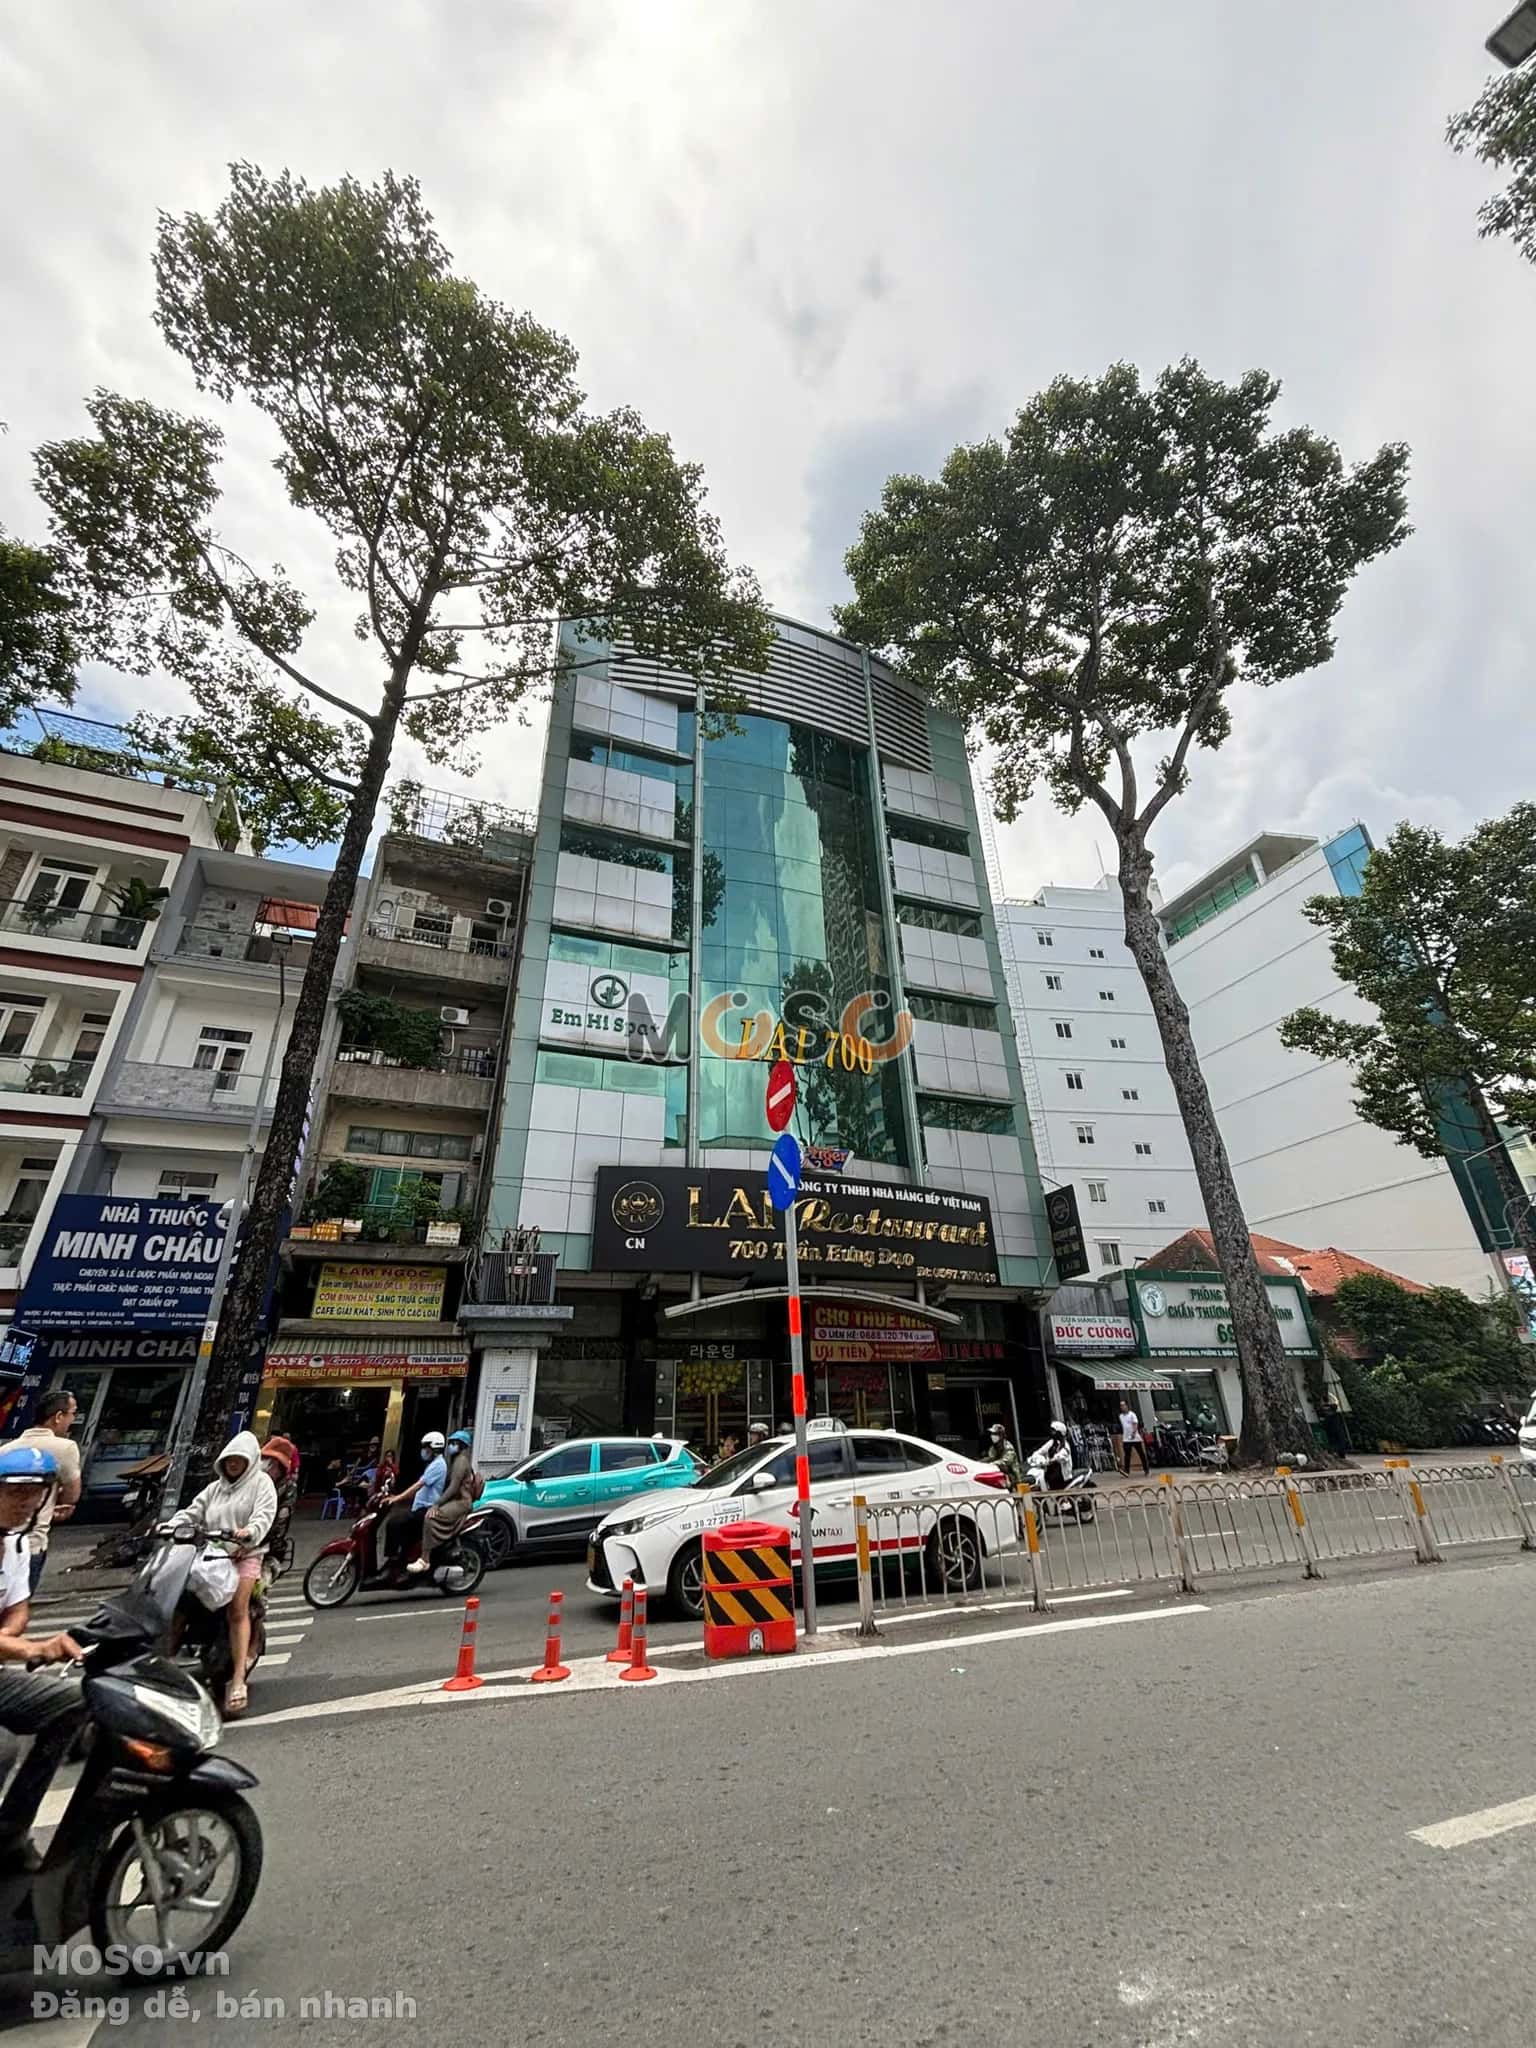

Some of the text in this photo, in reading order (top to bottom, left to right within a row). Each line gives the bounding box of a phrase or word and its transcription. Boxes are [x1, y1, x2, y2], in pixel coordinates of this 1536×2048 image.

[551, 1008, 649, 1037] Em Hi Spa
[736, 1018, 874, 1075] LAI 700
[824, 1183, 842, 1193] TY
[842, 1184, 869, 1197] TNHH
[873, 1186, 893, 1199] NHÀ
[896, 1189, 924, 1202] HÀNG
[925, 1191, 941, 1205] BẾP
[941, 1196, 961, 1209] VIỆT
[961, 1199, 982, 1211] NAM
[100, 1203, 209, 1227] NHÀ THUỐC
[686, 1186, 989, 1248] LAI Restaurant
[52, 1231, 138, 1261] MINH
[144, 1231, 224, 1264] CHÂU
[625, 1237, 646, 1249] CN
[729, 1240, 768, 1260] 700
[772, 1240, 821, 1261] Tần
[1189, 1286, 1223, 1300] PHÒNG
[815, 1308, 850, 1327] CHO
[1056, 1323, 1132, 1338] ĐỨC CƯỜNG
[50, 1339, 133, 1357] MINH
[690, 1344, 735, 1359] 라운딩
